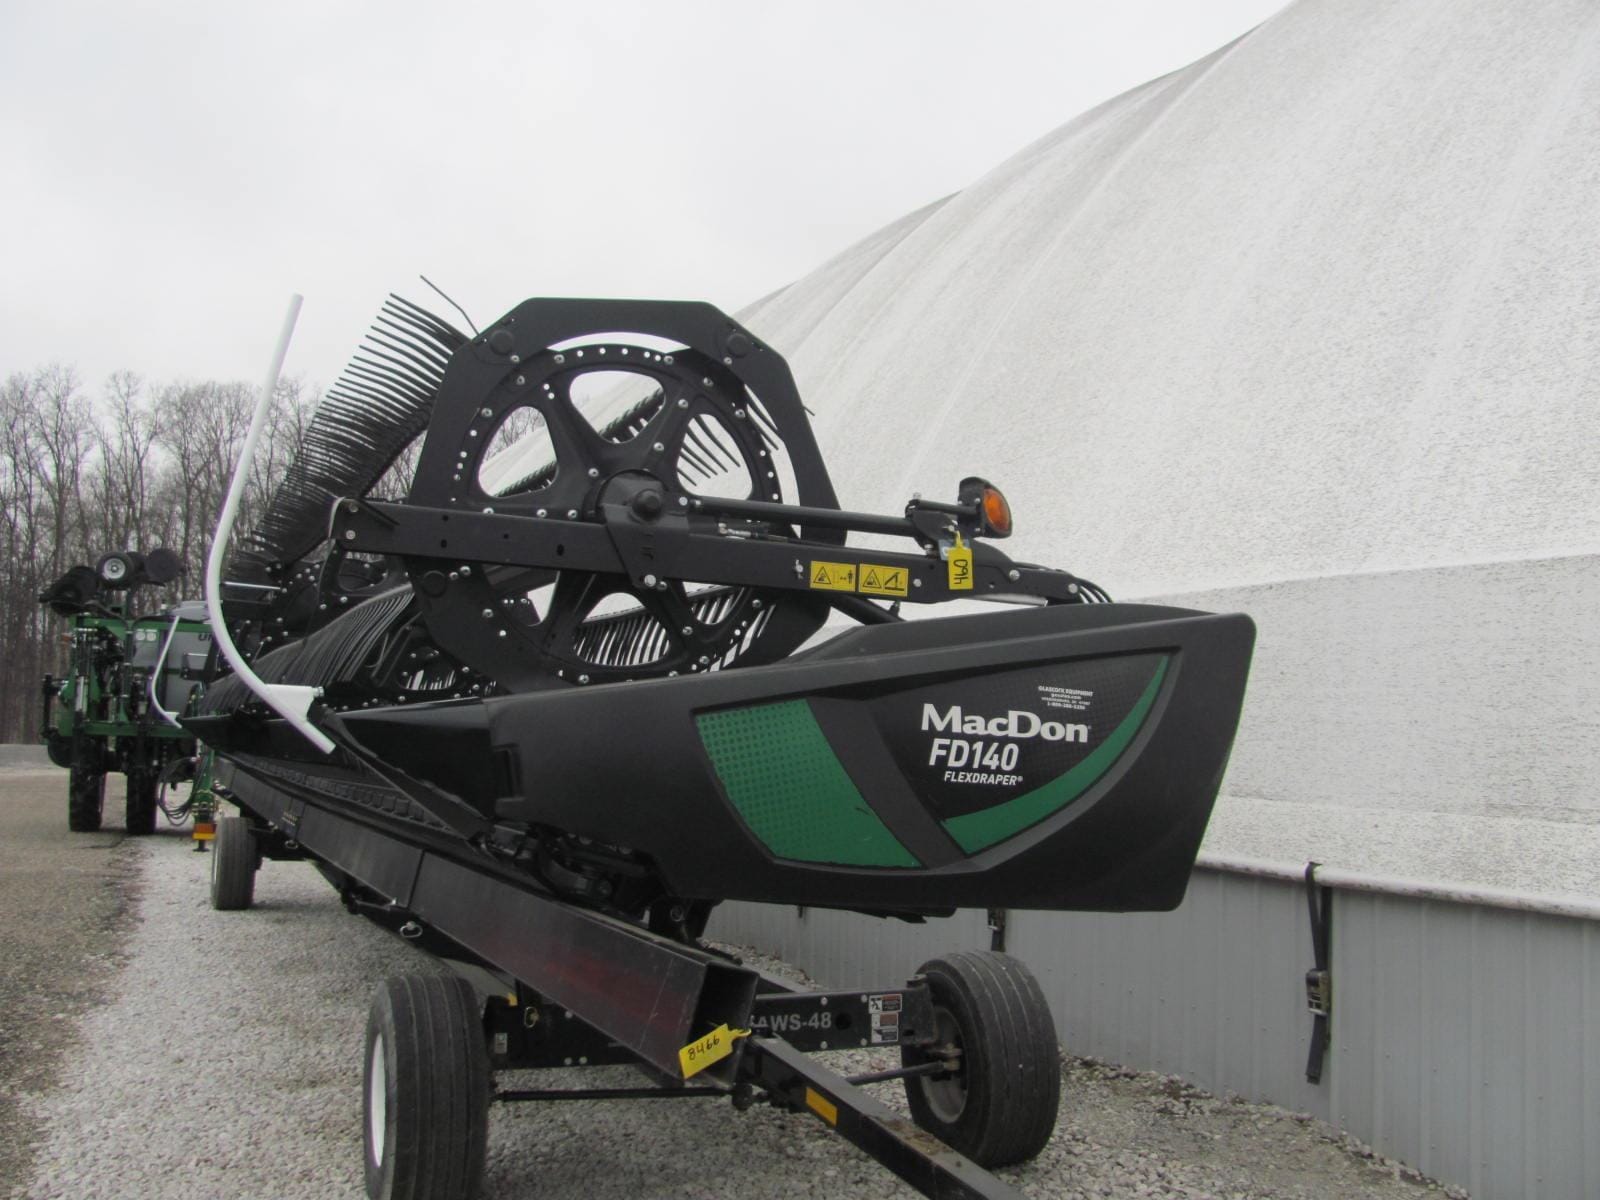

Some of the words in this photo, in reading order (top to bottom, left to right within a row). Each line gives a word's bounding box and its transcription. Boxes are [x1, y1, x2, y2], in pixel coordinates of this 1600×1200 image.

[953, 559, 968, 584] 460
[921, 703, 1089, 743] MacDon
[929, 738, 1019, 771] FD140
[688, 1035, 719, 1060] 8466
